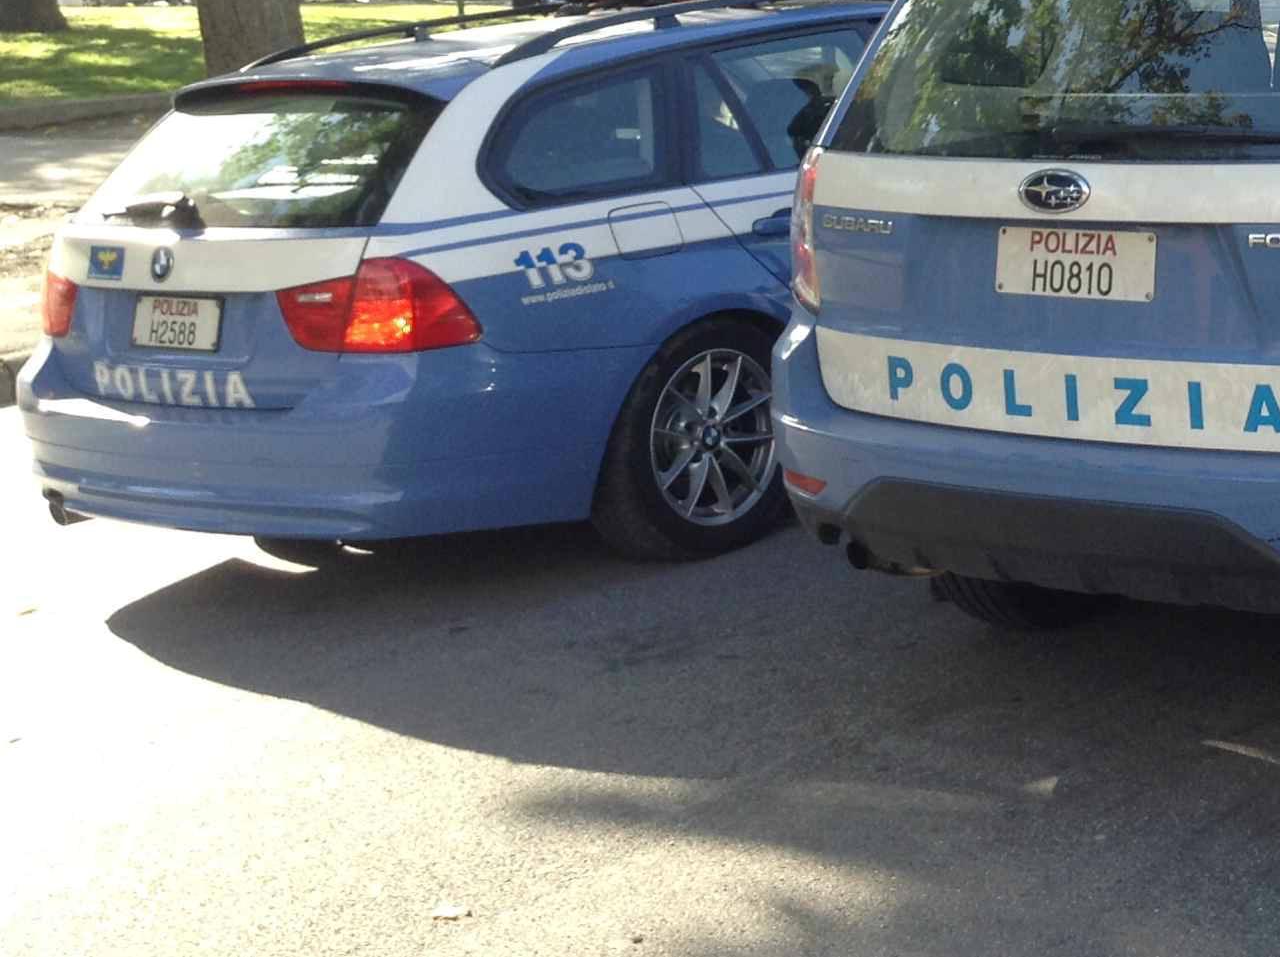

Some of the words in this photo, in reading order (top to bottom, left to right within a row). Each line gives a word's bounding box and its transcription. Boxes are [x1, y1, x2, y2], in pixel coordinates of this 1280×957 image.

[823, 214, 893, 234] SUBARU
[1030, 231, 1117, 256] POLIZIA
[513, 242, 592, 289] 113
[1031, 259, 1113, 296] H0810
[152, 299, 199, 316] POLIZIA
[150, 320, 197, 346] H2588
[94, 360, 256, 408] POLIZIA
